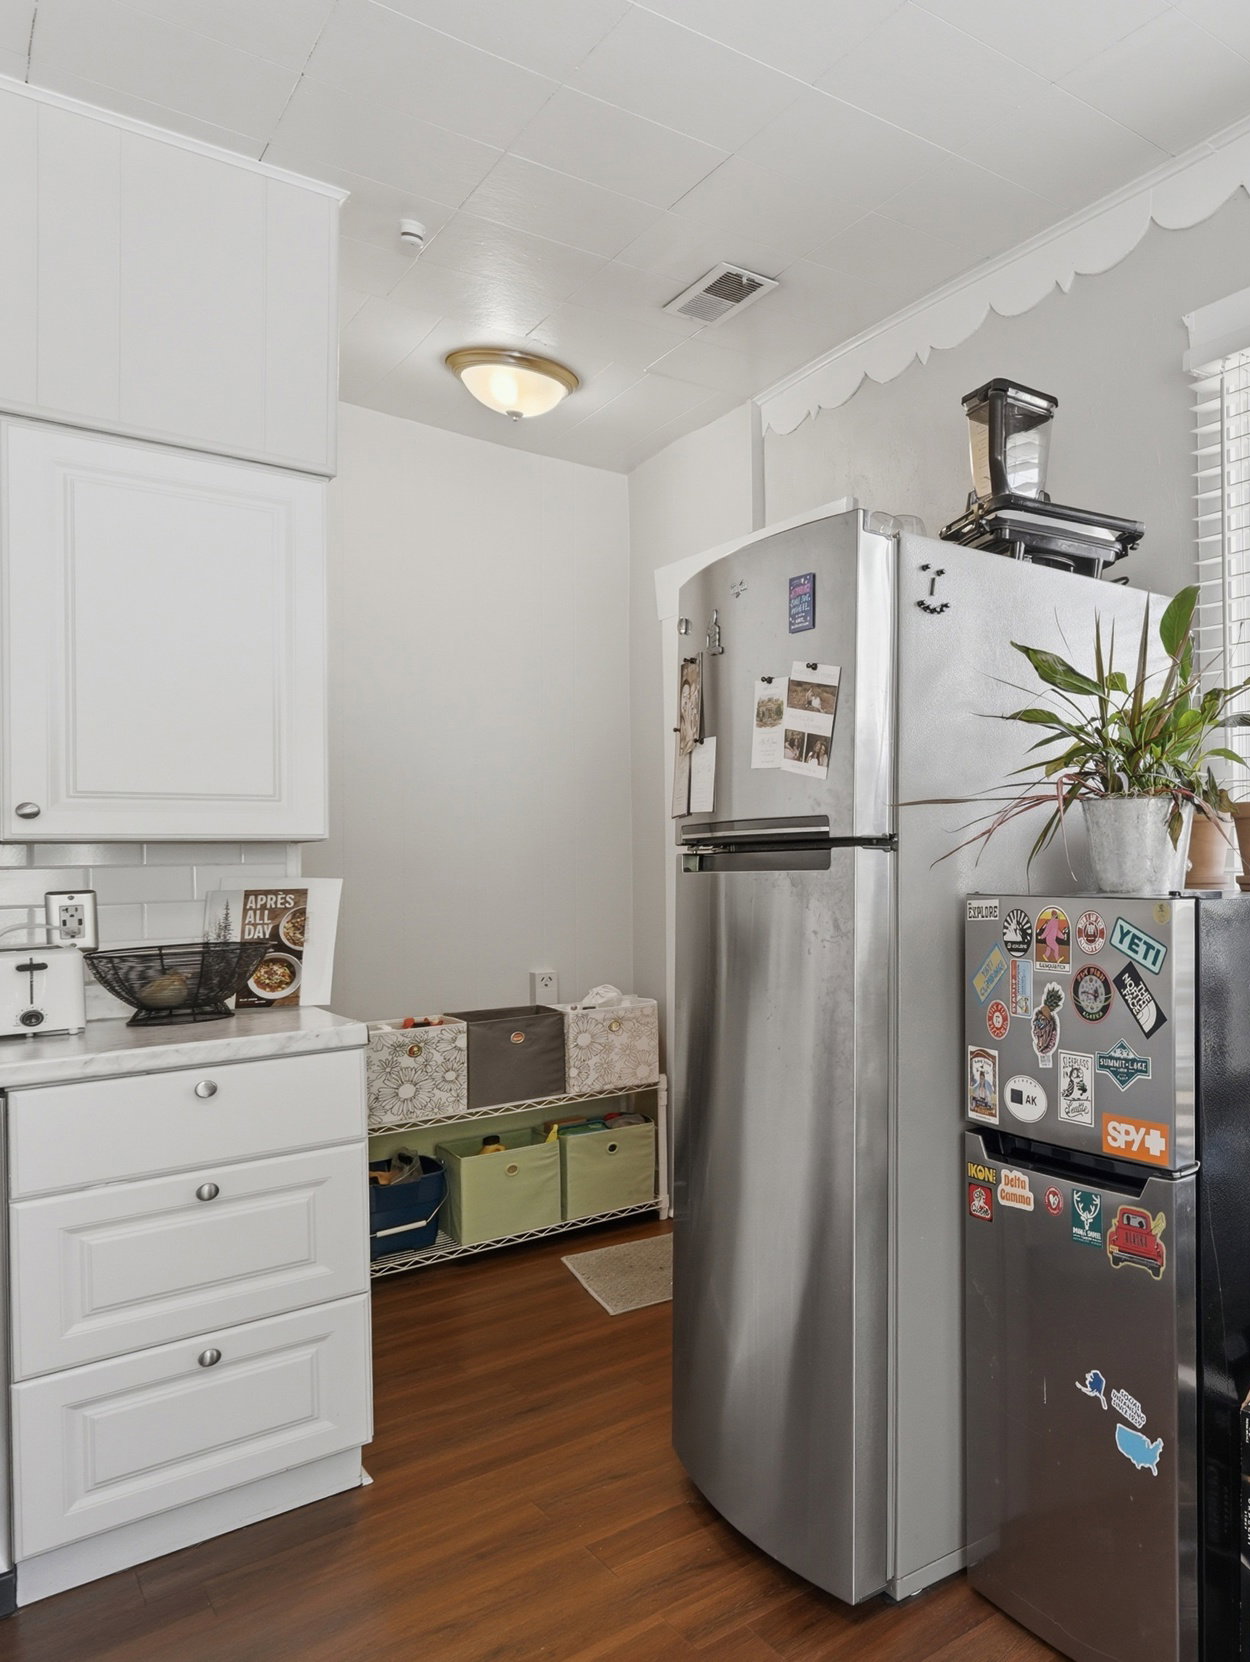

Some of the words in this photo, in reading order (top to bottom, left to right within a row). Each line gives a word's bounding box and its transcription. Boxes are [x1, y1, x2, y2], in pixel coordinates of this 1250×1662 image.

[246, 891, 295, 909] APRÈS
[245, 910, 272, 924] ALL
[968, 905, 998, 919] EXPLORE
[244, 924, 274, 940] DAY
[1118, 924, 1161, 967] YETI
[1122, 972, 1148, 1011] NORTH
[1139, 981, 1153, 1003] THE
[1122, 989, 1140, 1016] FACE
[1099, 1058, 1126, 1068] SUMMIT
[1025, 1094, 1038, 1106] AK
[967, 1162, 993, 1183] IKON
[1004, 1174, 1027, 1190] Delta
[1119, 1390, 1141, 1411] SOCIAL
